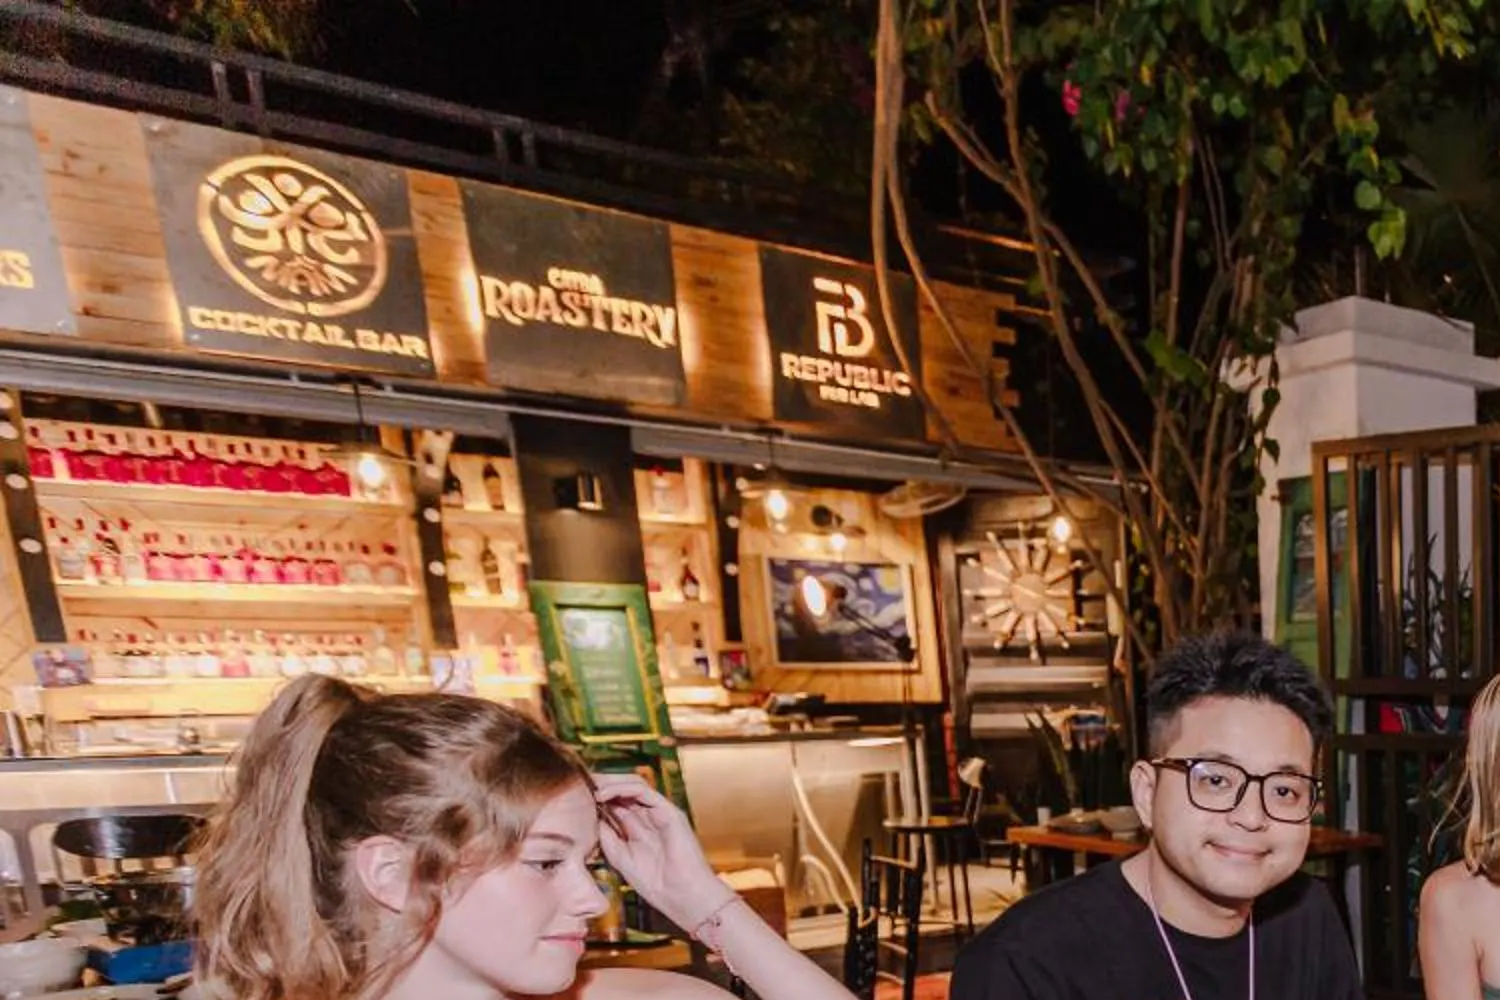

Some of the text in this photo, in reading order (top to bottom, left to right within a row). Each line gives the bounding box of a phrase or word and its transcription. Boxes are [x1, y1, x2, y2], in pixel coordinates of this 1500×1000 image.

[188, 306, 428, 359] COCKTAIL BAR
[480, 275, 677, 349] ROASTERY
[780, 352, 911, 397] REPUBLIC
